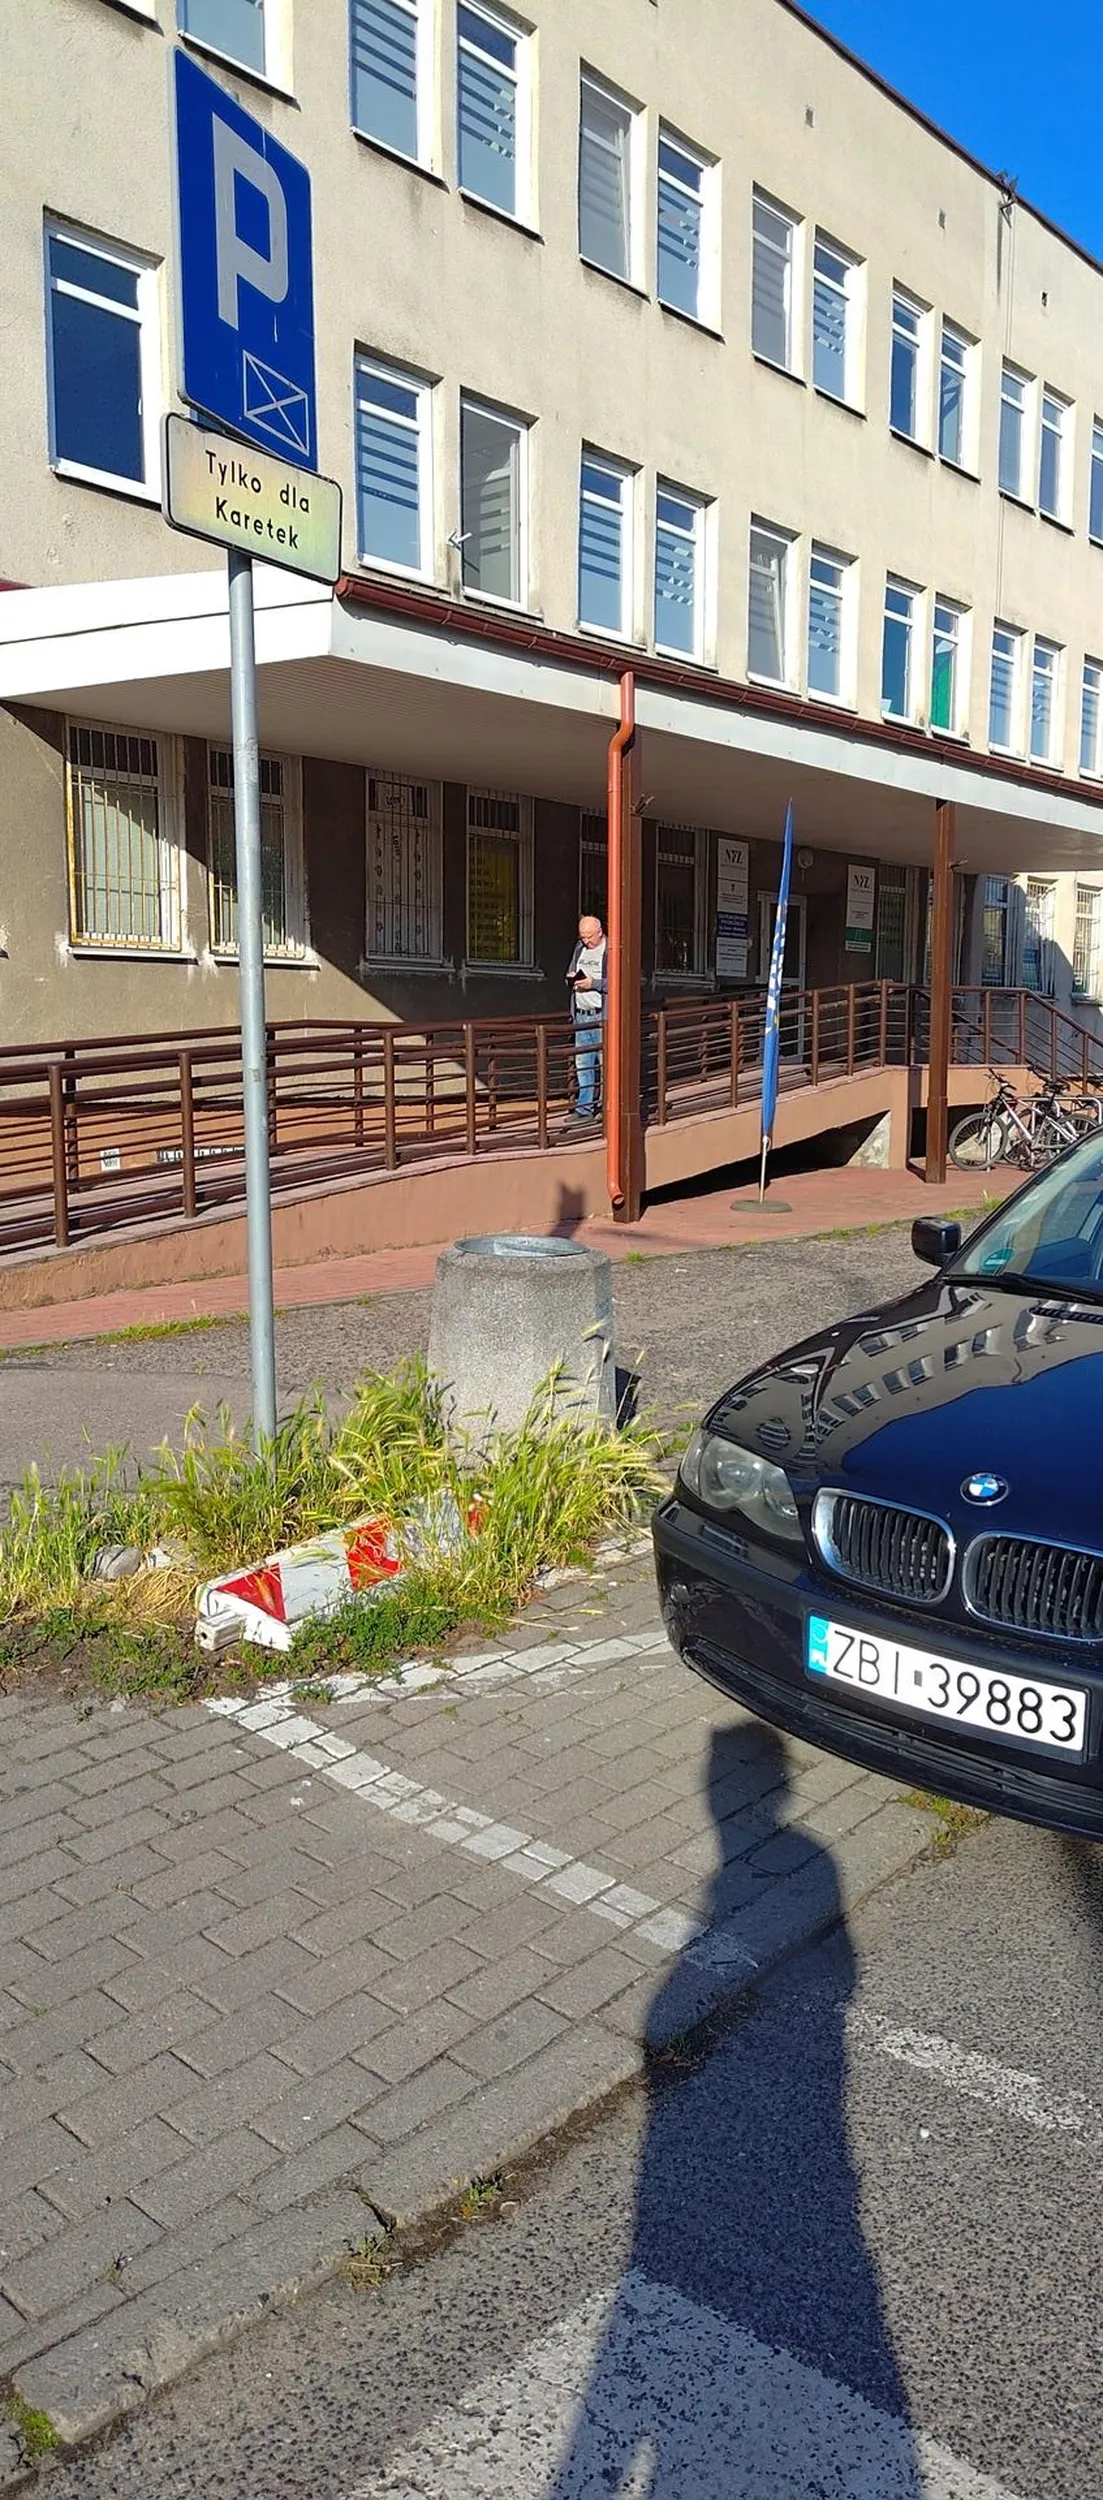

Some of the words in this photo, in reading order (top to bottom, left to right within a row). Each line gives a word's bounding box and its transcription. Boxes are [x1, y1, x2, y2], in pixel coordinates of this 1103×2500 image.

[212, 111, 289, 332] P
[205, 450, 262, 493] Tylko
[279, 483, 309, 513] dla
[216, 497, 299, 549] Karetek
[928, 1663, 1077, 1742] 39883
